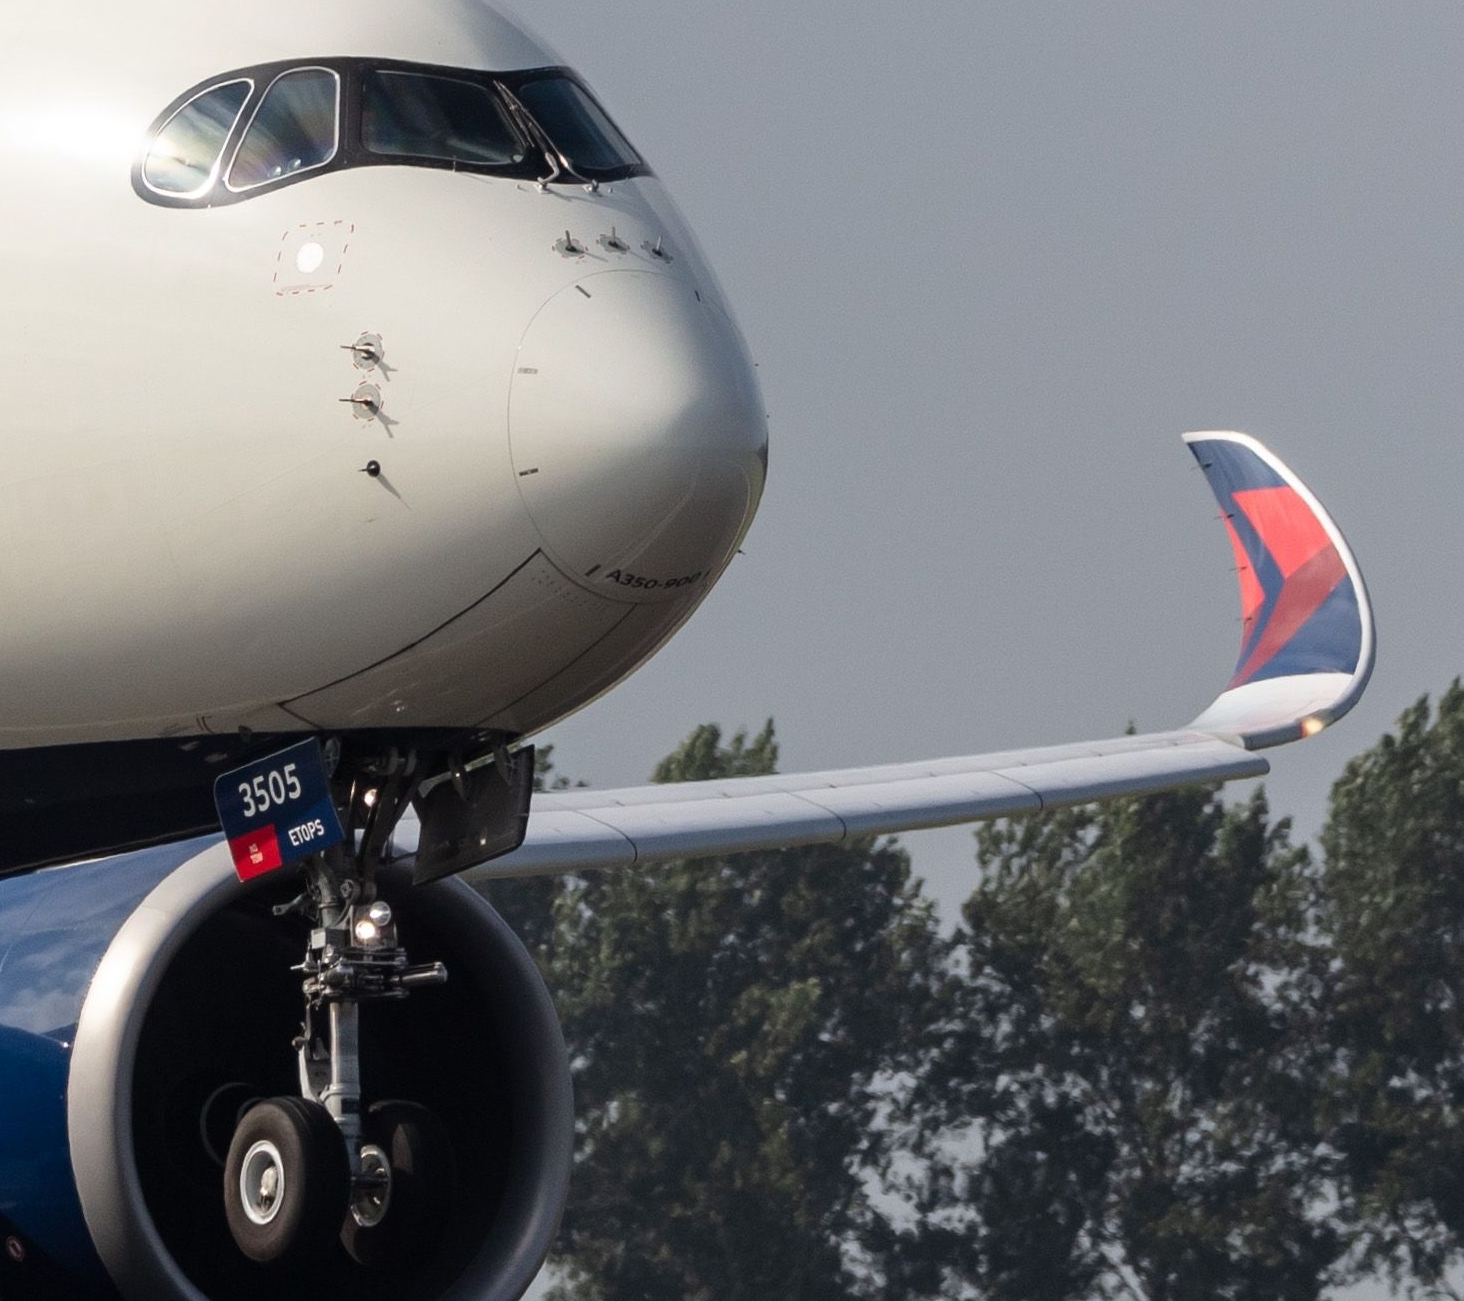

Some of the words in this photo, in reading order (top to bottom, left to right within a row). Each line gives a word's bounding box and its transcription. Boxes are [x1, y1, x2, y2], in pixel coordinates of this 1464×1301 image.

[605, 569, 703, 590] A350-900
[238, 763, 302, 818] 3505
[287, 818, 325, 847] ETOPS
